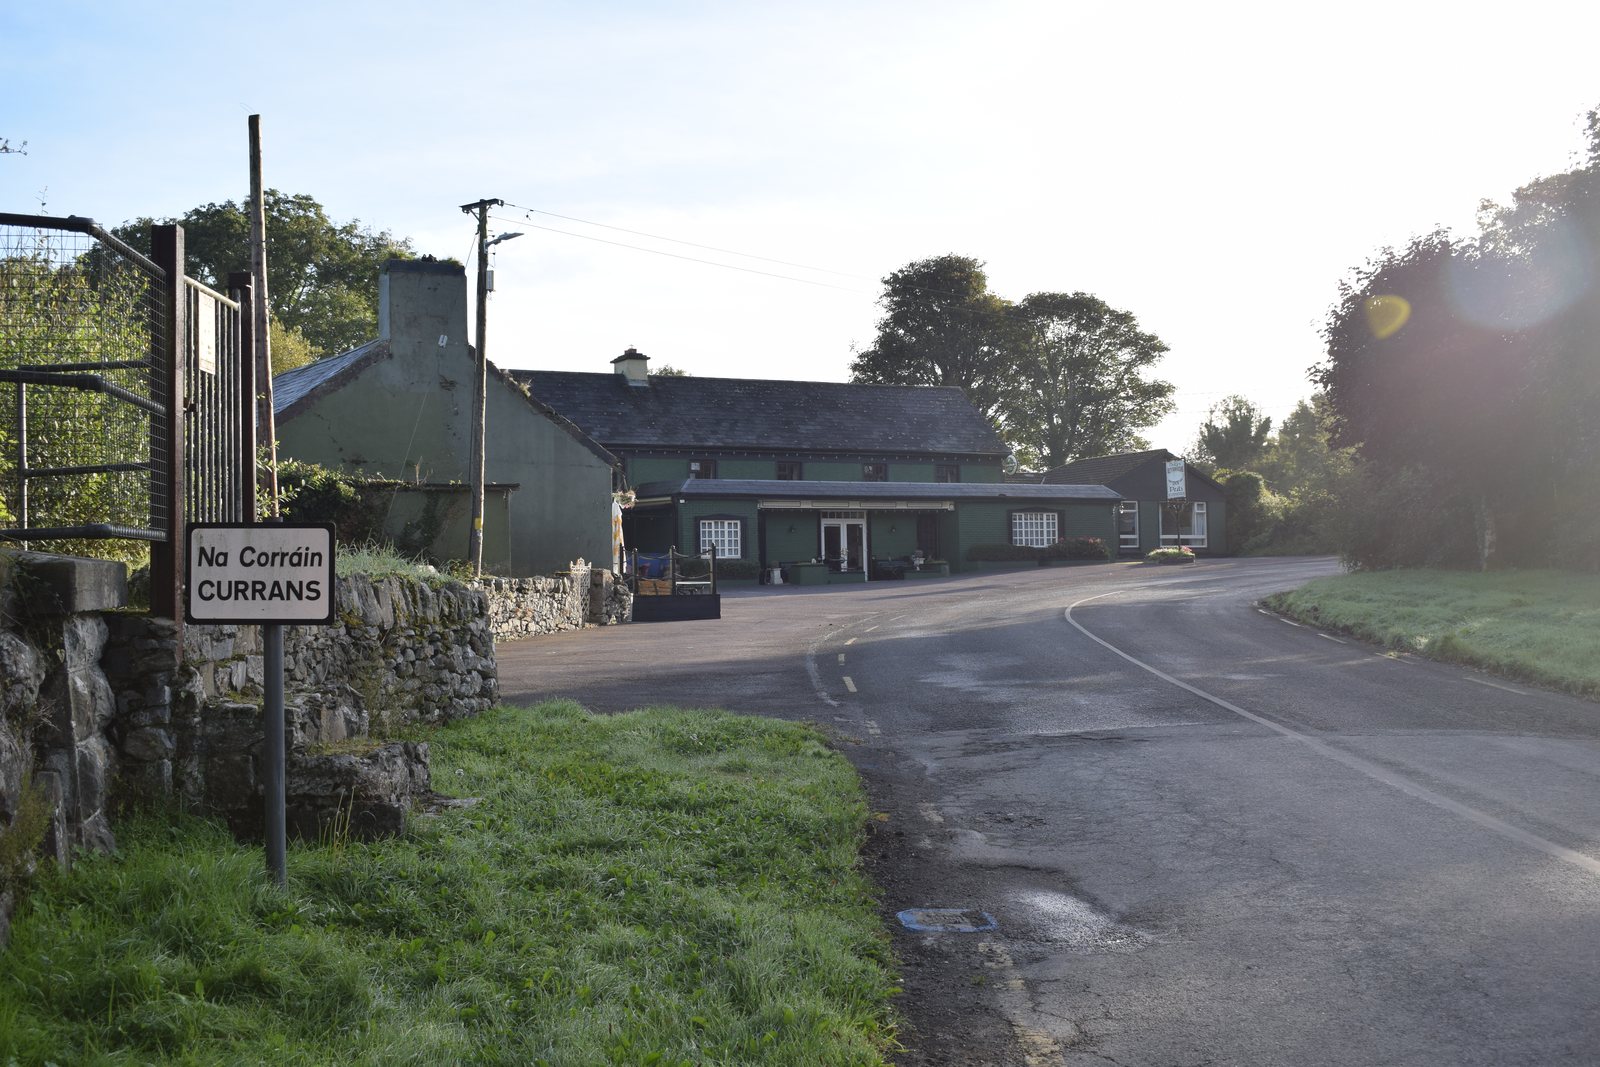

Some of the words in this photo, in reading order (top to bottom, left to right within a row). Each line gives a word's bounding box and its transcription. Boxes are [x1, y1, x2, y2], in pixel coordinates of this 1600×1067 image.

[197, 546, 229, 567] Na
[239, 545, 323, 568] Corráin
[197, 579, 321, 602] CURRANS
